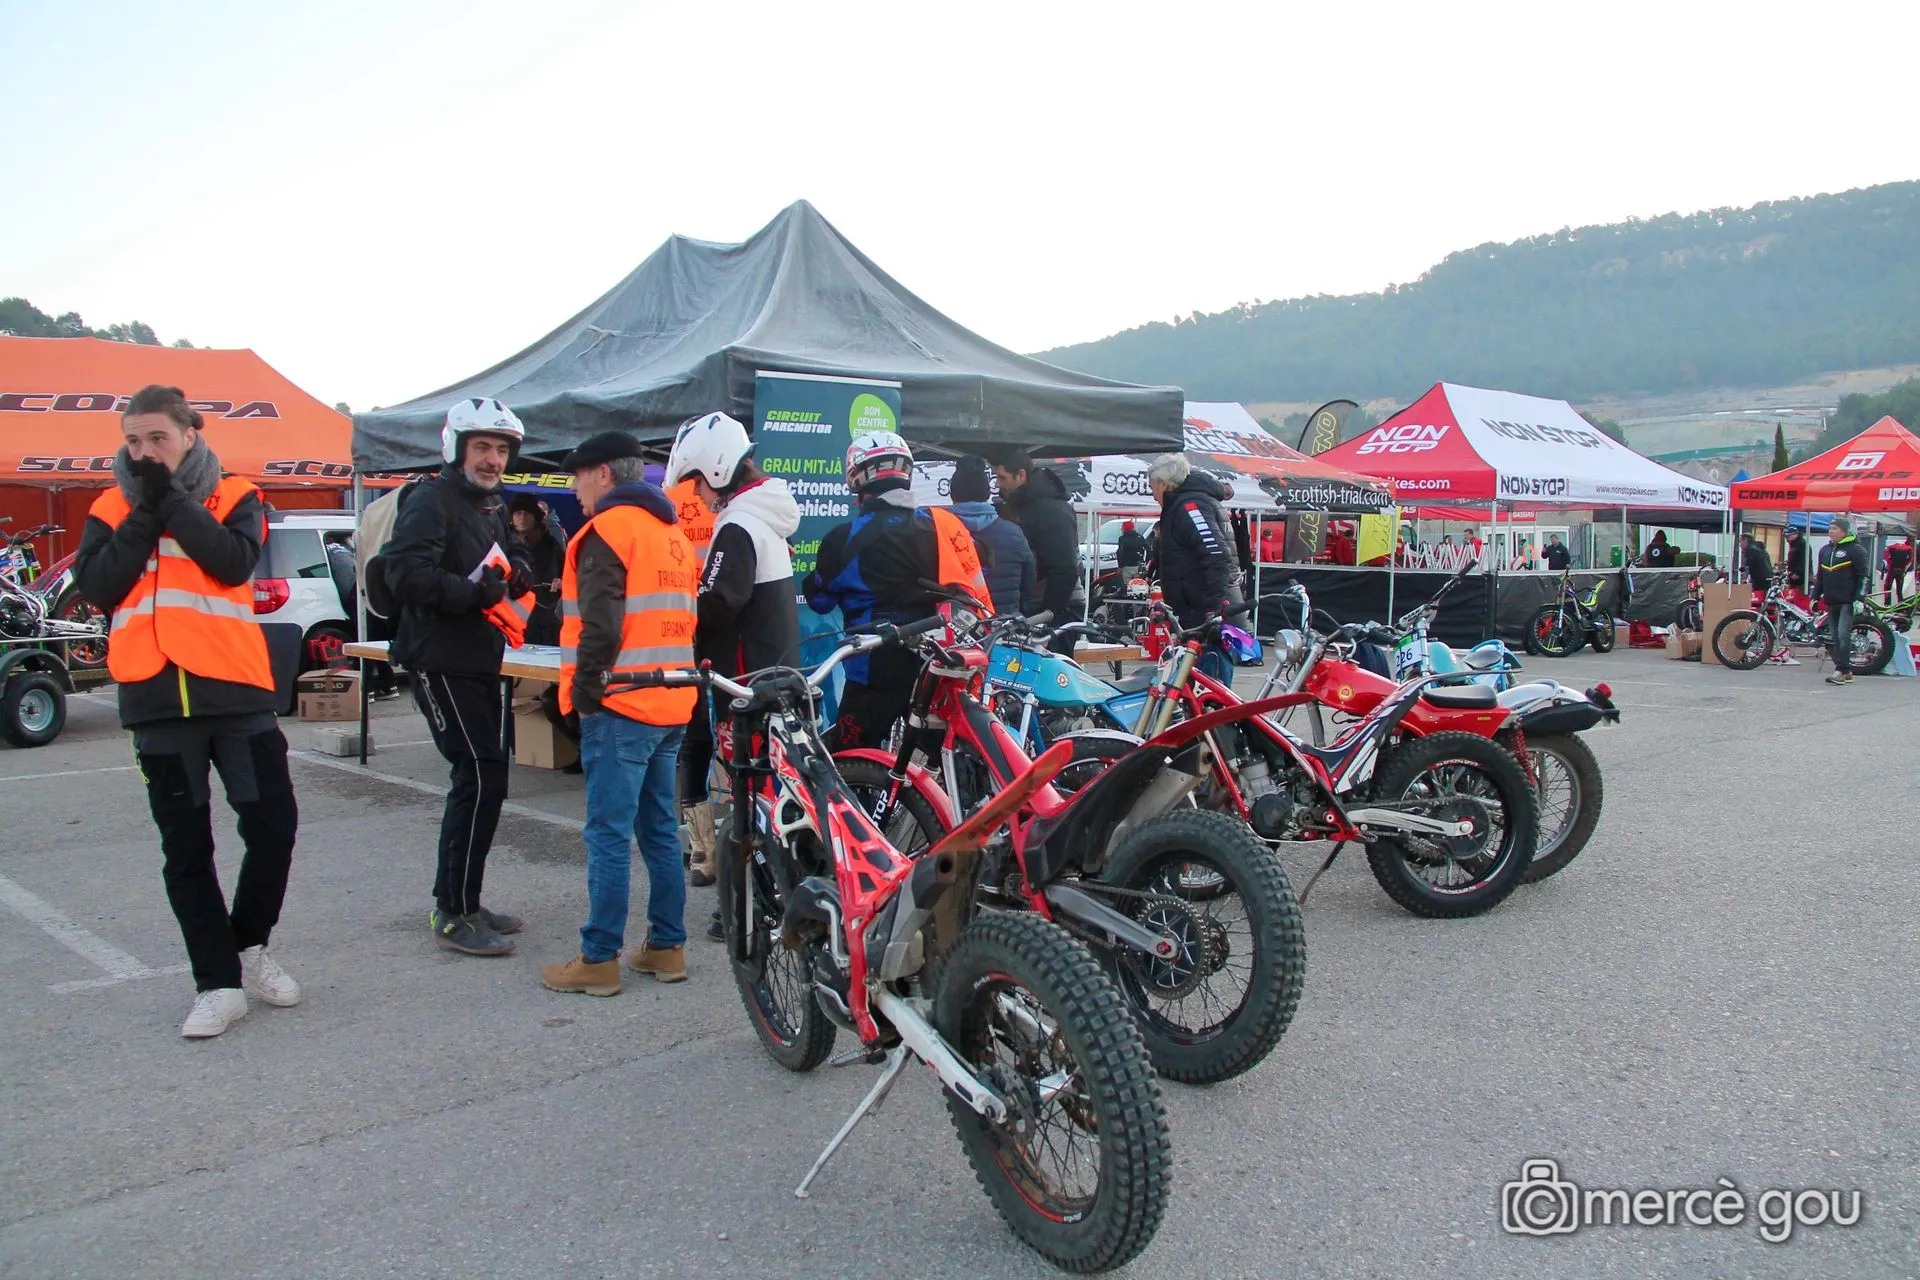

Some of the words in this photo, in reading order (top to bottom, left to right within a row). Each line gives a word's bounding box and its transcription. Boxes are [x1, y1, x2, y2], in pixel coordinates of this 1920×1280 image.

[766, 410, 822, 423] CIRCUIT
[863, 406, 881, 416] SOM
[762, 421, 833, 434] PARCMOTOR
[857, 417, 889, 428] CENTRE
[1367, 425, 1450, 441] NON
[1481, 418, 1546, 442] NON
[1537, 424, 1601, 449] STOP
[1355, 441, 1439, 455] STOP
[762, 457, 801, 474] GRAU
[803, 457, 842, 475] MITJÀ
[1784, 471, 1914, 482] COMAS
[1500, 475, 1529, 495] NON
[1532, 478, 1565, 496] STOP
[1596, 485, 1659, 497] www.nonstopbikes.com
[1287, 483, 1388, 507] scottish-trial.com
[1678, 486, 1698, 502] NON
[1700, 490, 1723, 506] STOP
[1738, 489, 1799, 500] COMAS
[798, 499, 849, 517] ehicles
